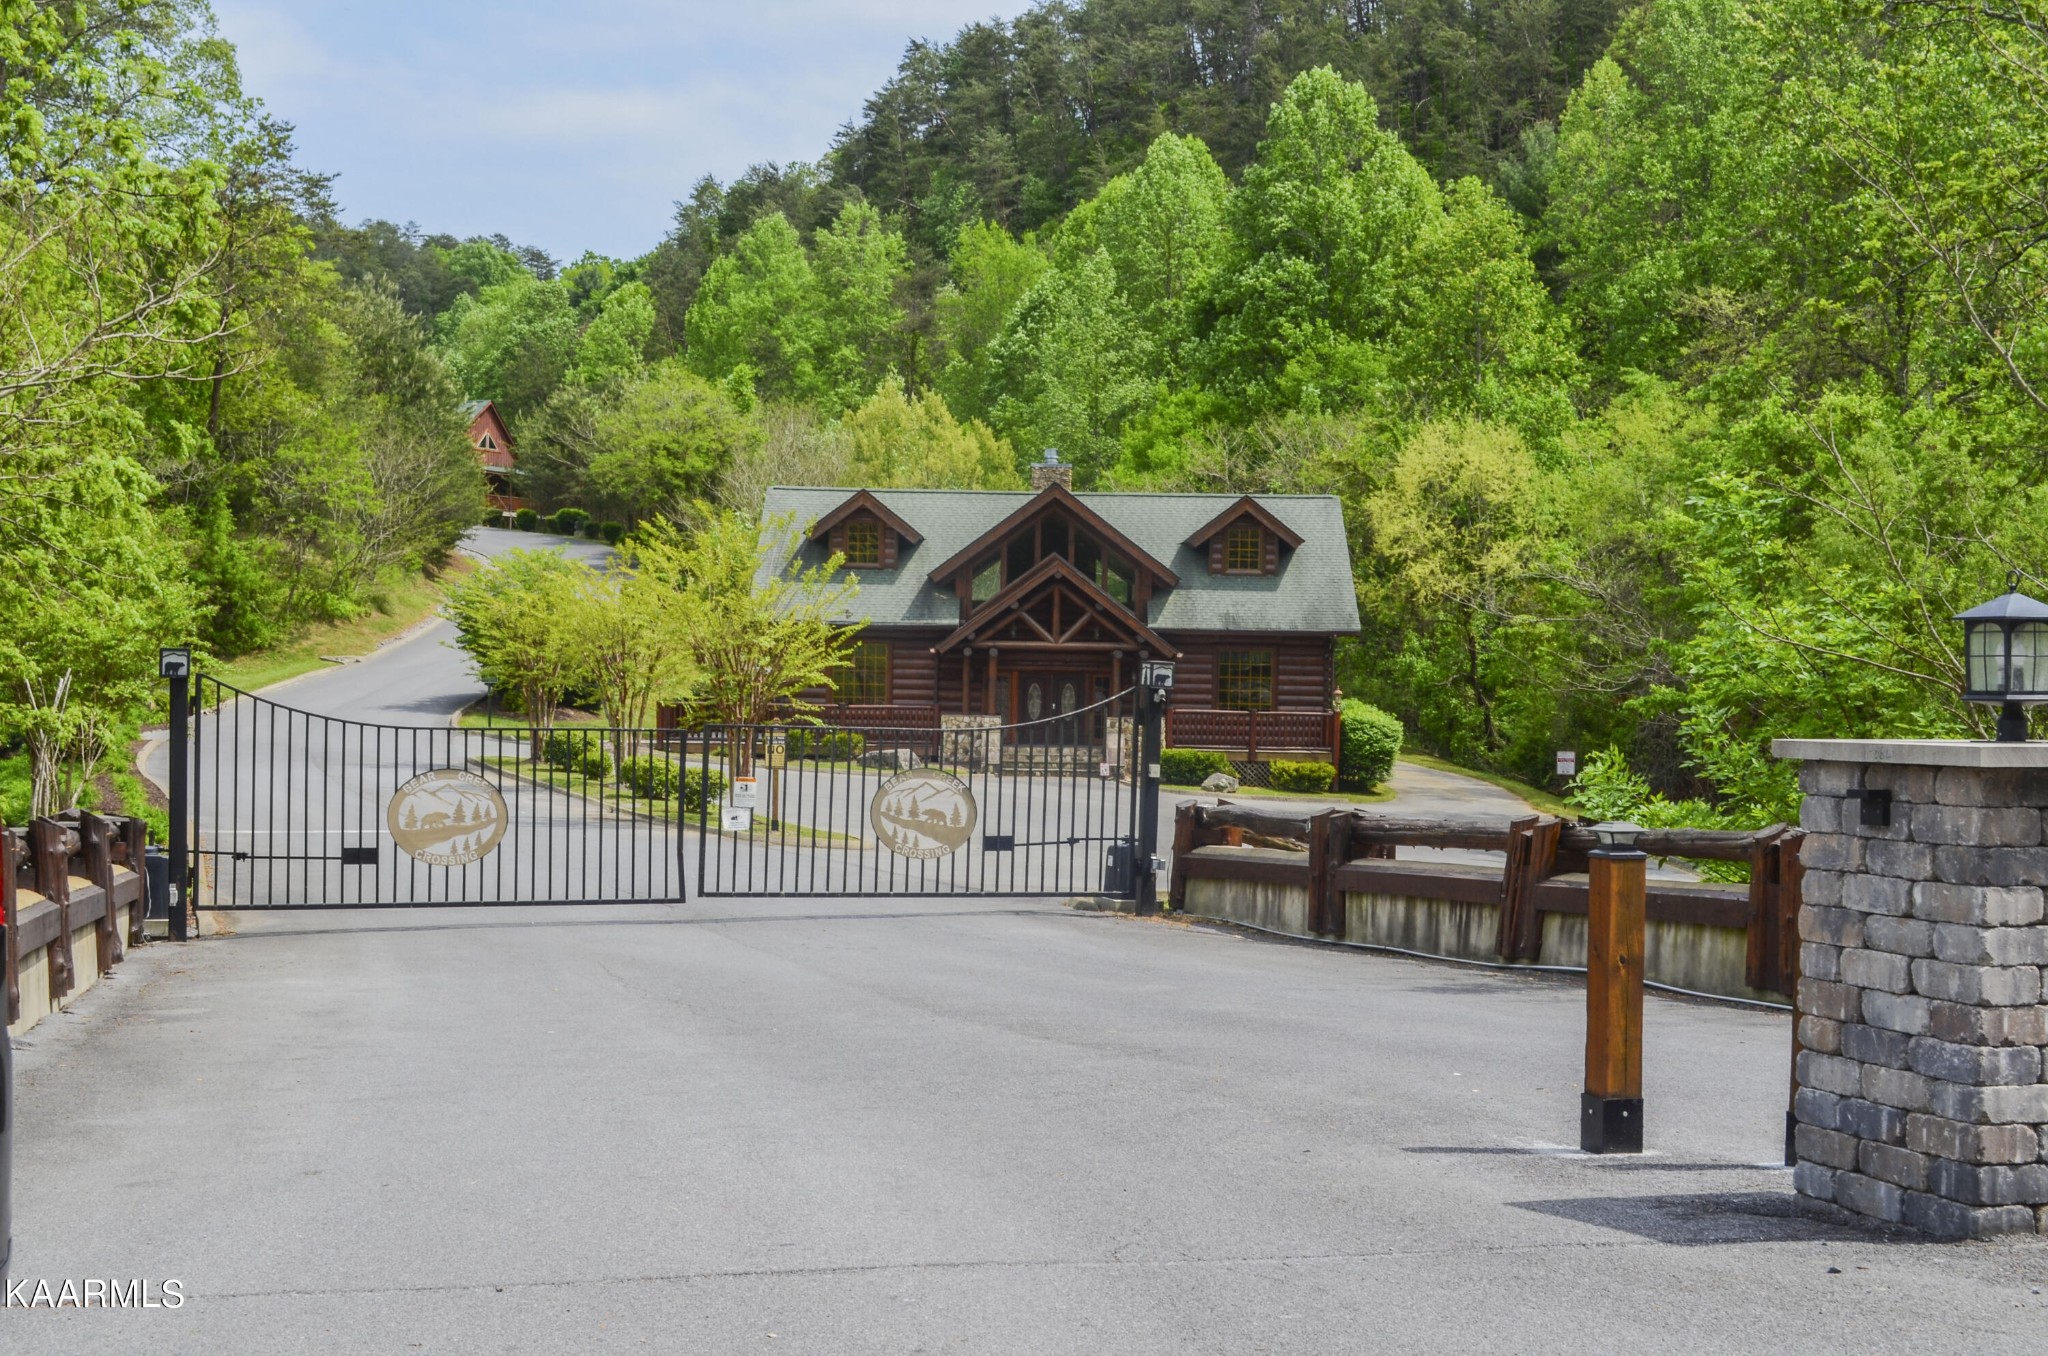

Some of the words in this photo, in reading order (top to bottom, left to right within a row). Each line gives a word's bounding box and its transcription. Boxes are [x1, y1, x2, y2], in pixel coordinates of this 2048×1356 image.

[403, 771, 436, 794] BEAR
[458, 771, 496, 798] CREEK
[884, 770, 914, 791] BEAR
[933, 771, 966, 793] CREEK
[415, 849, 478, 865] CROSSING
[894, 844, 951, 858] CROSSING
